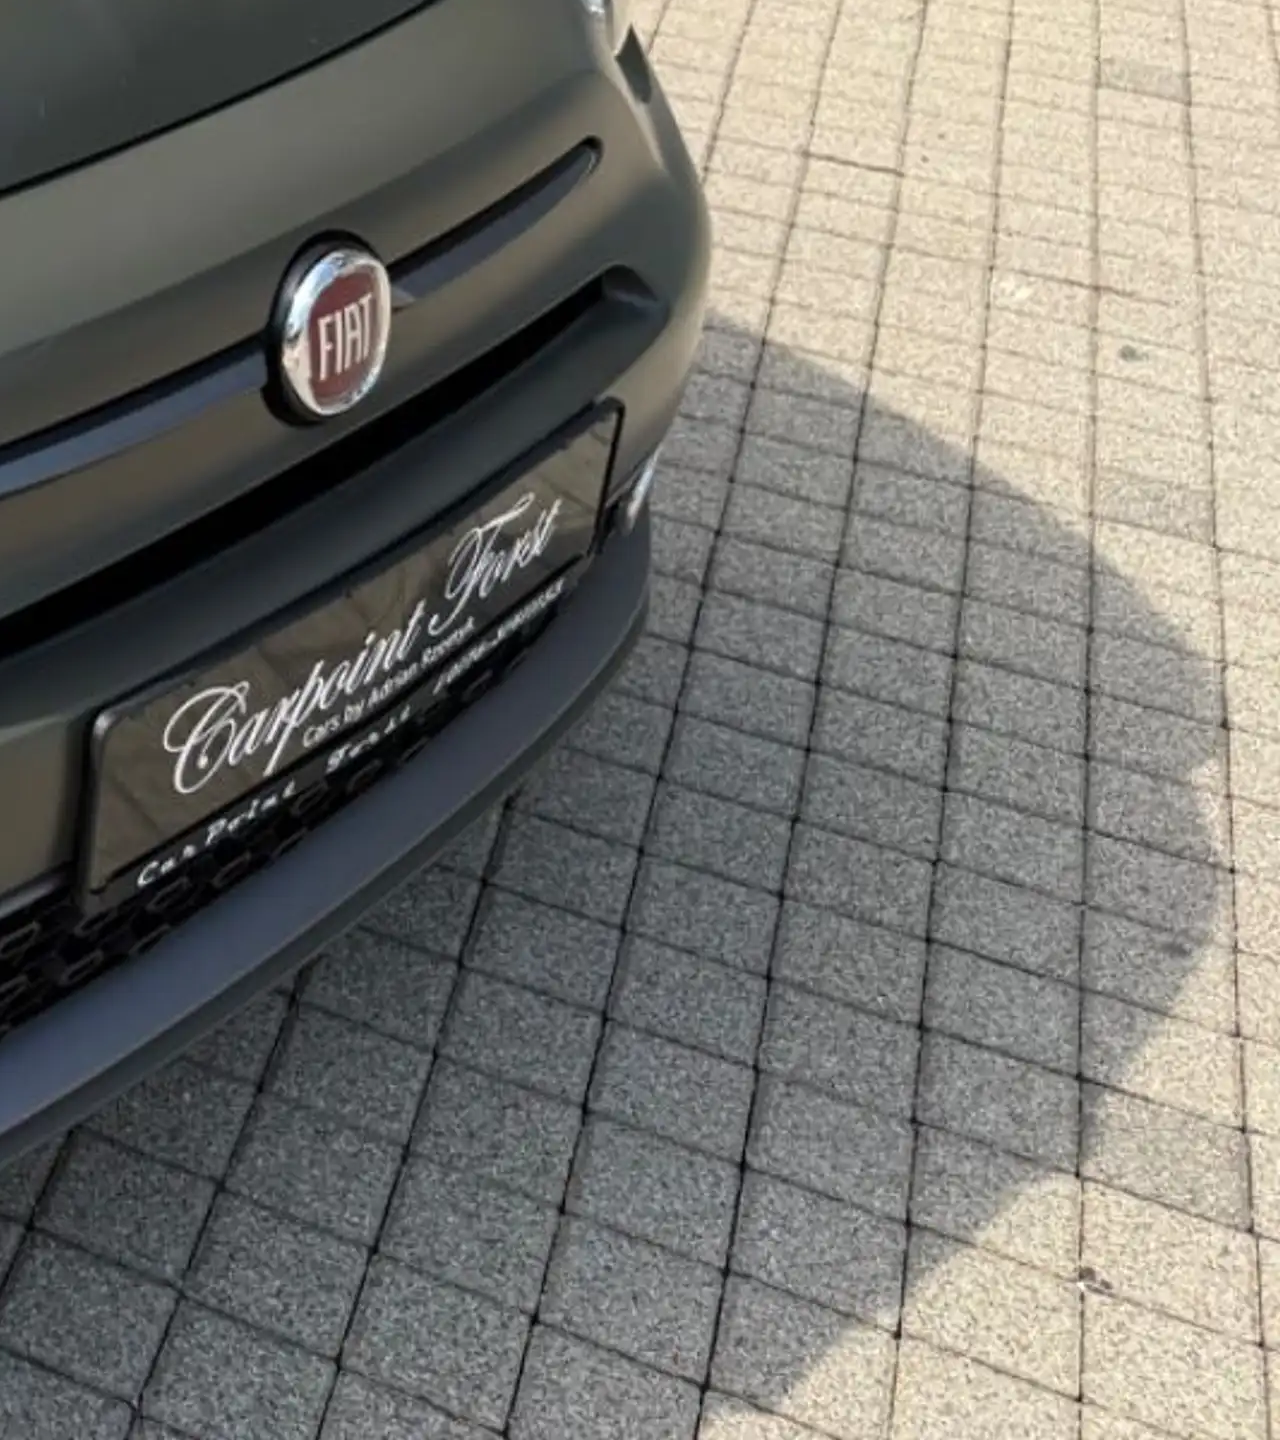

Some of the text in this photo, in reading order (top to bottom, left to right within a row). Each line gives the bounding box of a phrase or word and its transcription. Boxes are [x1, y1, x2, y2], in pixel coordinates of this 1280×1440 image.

[316, 293, 373, 381] FIAT
[163, 599, 426, 794] Carpoint
[428, 492, 563, 637] Forst
